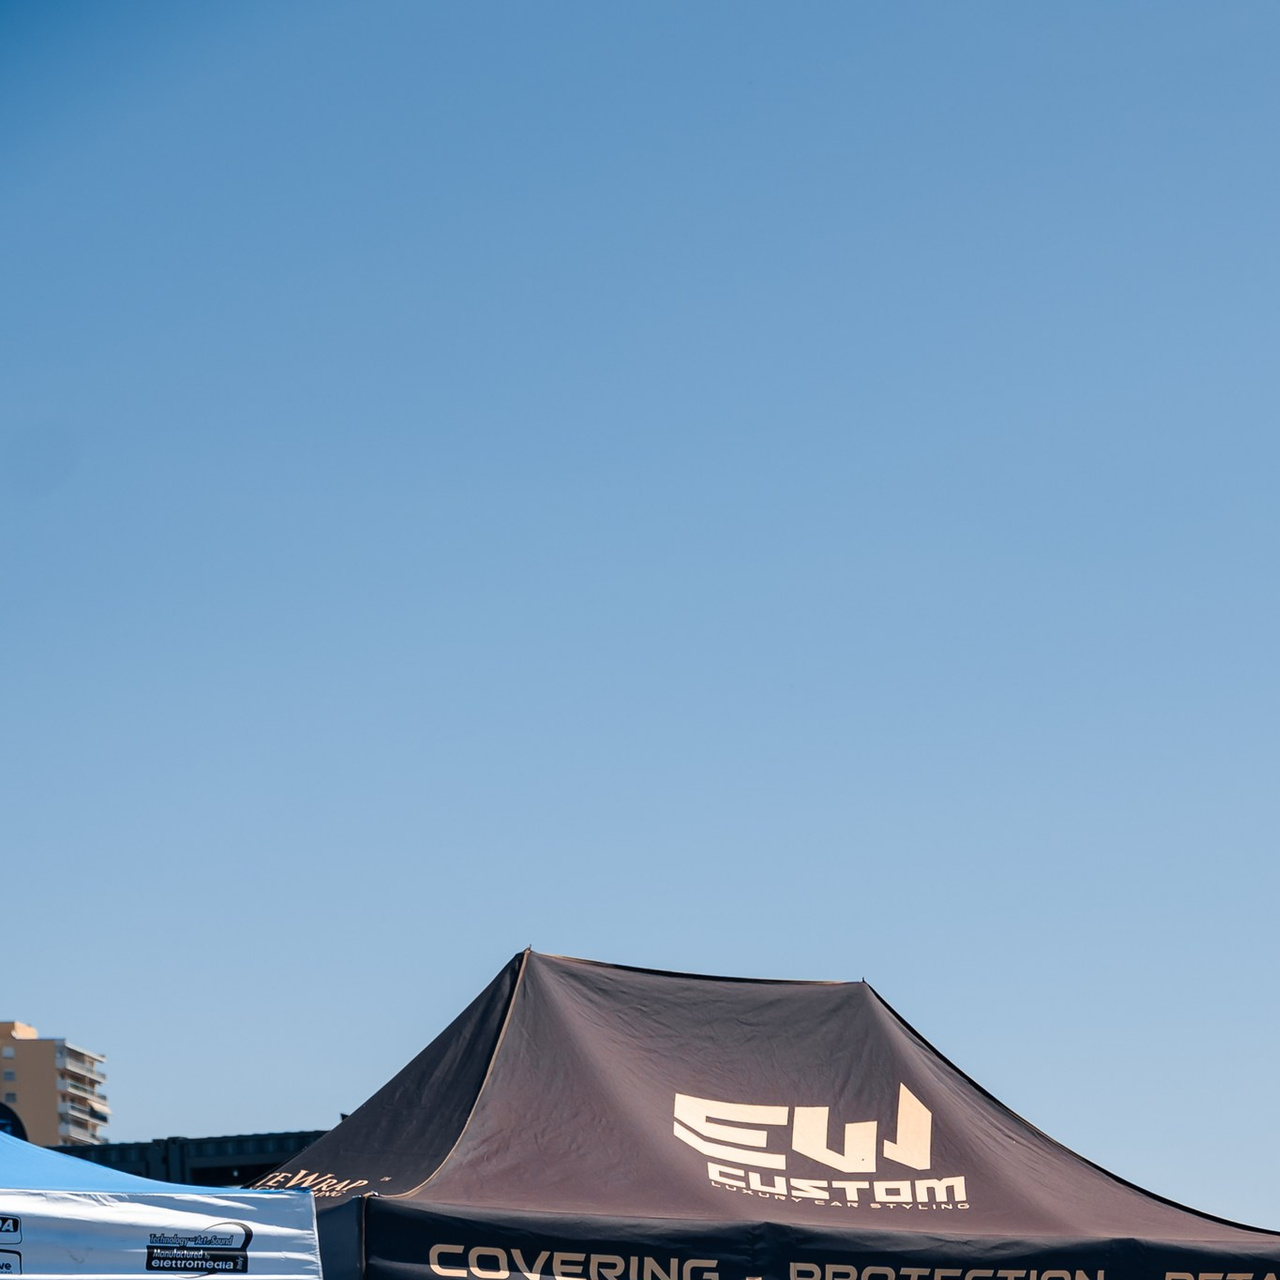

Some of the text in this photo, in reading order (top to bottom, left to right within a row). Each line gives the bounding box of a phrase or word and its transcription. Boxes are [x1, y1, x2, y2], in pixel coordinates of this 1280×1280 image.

[706, 1162, 967, 1203] CUSTOM
[710, 1180, 970, 1210] LUXURY CAR STYLING
[149, 1233, 190, 1246] Technology
[211, 1235, 234, 1246] Sound
[152, 1249, 204, 1259] Manufactured
[151, 1259, 234, 1270] elettromedia
